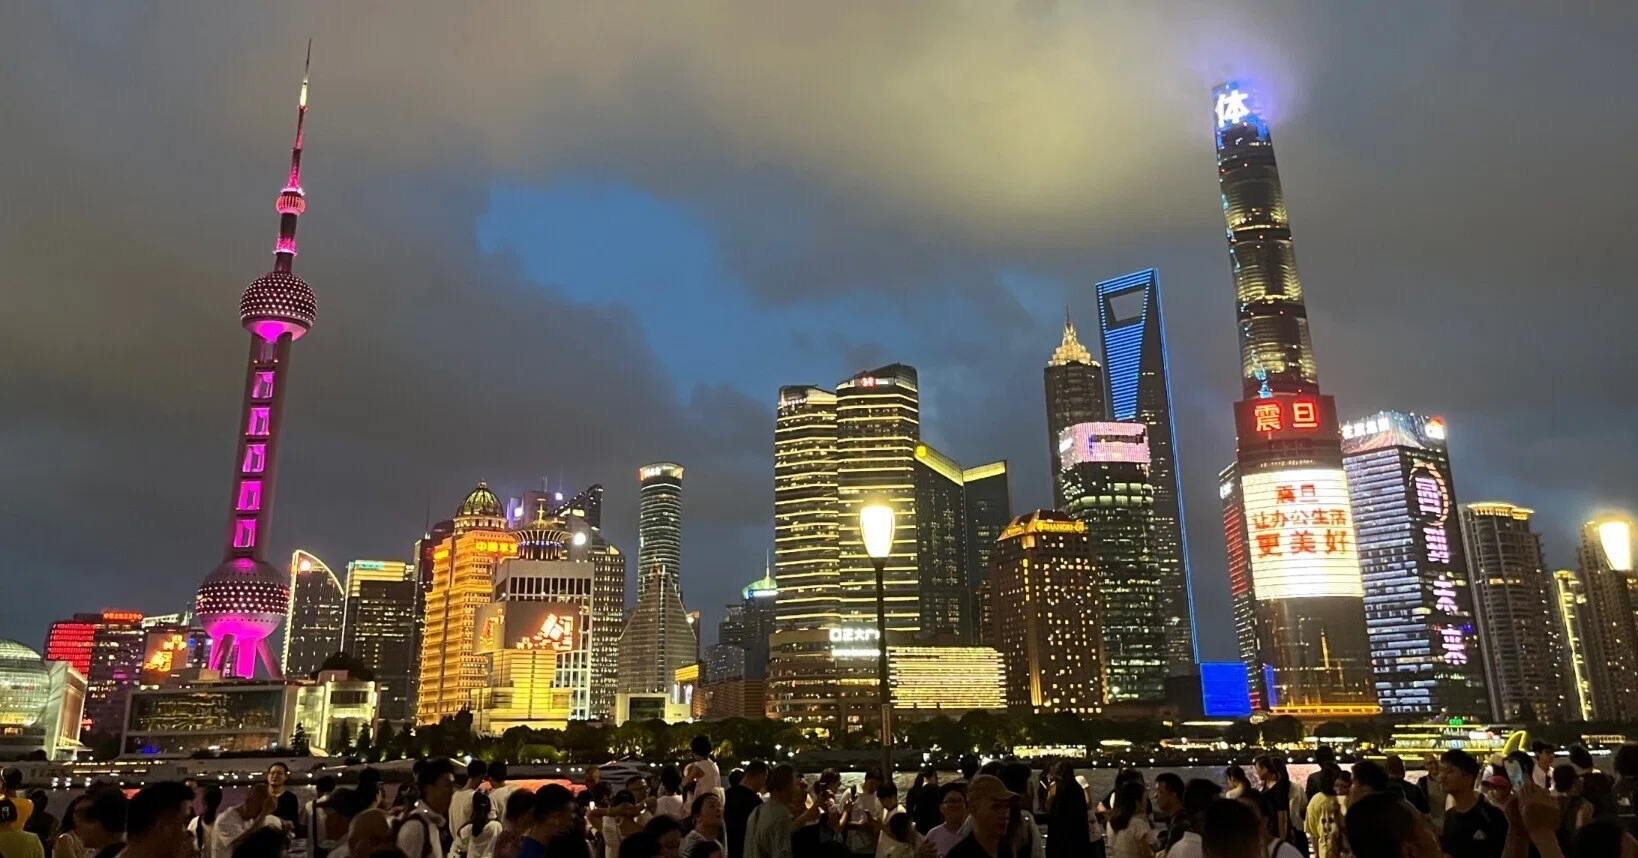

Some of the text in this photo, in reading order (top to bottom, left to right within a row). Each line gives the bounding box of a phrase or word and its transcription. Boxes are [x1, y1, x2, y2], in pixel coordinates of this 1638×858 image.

[1215, 90, 1250, 127] 体
[1255, 403, 1318, 431] 震旦
[1276, 484, 1319, 504] 震旦
[1253, 508, 1345, 530] 让办公生活
[1256, 529, 1349, 558] 更美好
